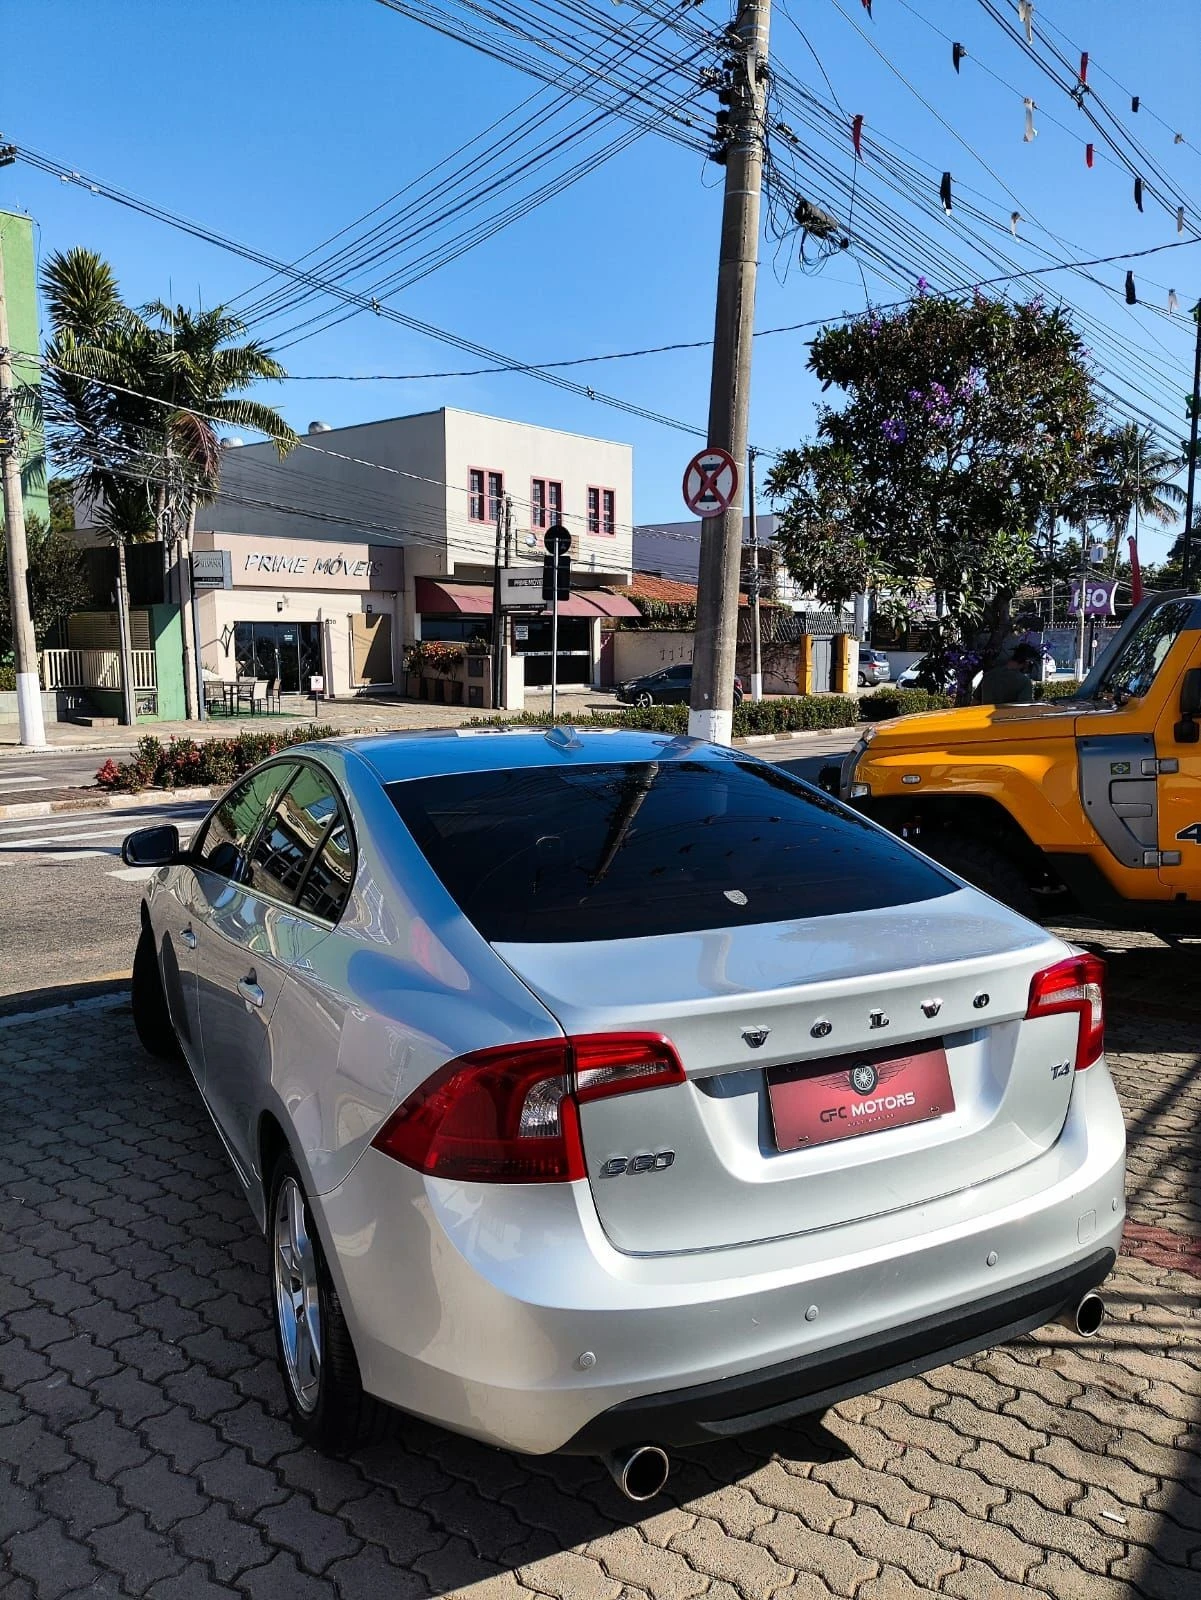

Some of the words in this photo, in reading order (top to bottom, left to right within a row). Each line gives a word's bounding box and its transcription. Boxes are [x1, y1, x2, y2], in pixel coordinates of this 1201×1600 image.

[244, 553, 309, 574] PRIME
[313, 552, 383, 577] MÓVEIS
[739, 991, 990, 1049] VOLVO
[1050, 1060, 1071, 1080] T4
[820, 1106, 847, 1123] CFC
[851, 1092, 916, 1117] MOTORS
[603, 1149, 676, 1177] S60
